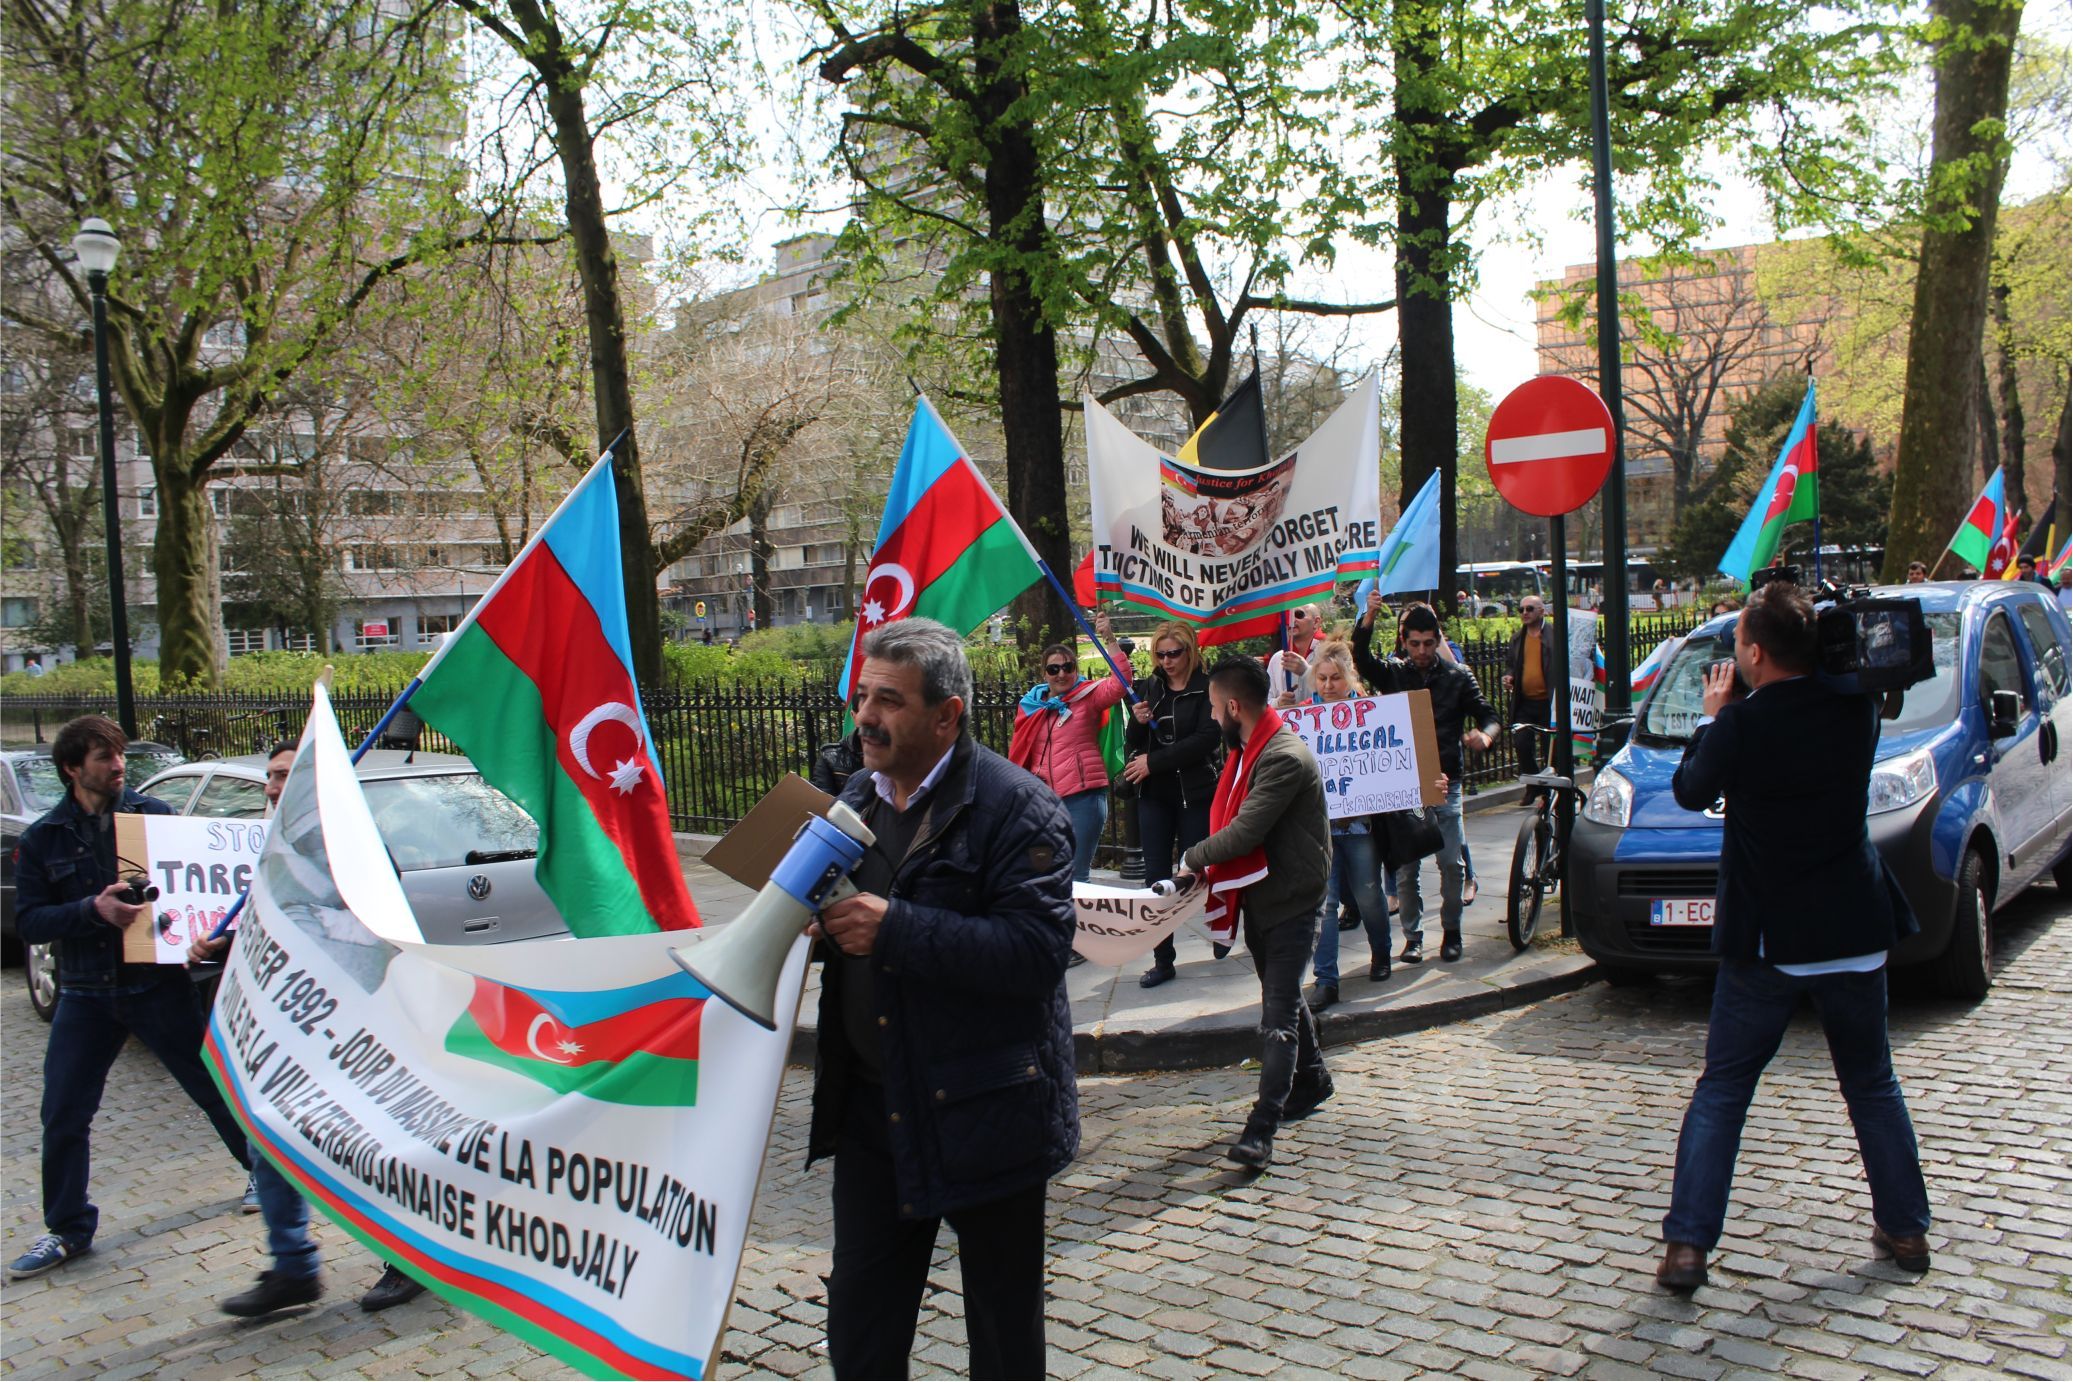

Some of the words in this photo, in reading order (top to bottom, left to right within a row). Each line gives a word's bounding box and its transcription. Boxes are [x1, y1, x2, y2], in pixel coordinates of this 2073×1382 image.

[1194, 474, 1233, 489] Justice
[1235, 477, 1254, 490] for
[1131, 525, 1151, 559] WE
[1153, 543, 1194, 581] WILL
[1200, 548, 1261, 585] NEVER
[1264, 506, 1338, 552] FORGET
[1180, 584, 1205, 607] OF
[1282, 700, 1376, 734] STOP
[1665, 902, 1715, 922] 1-EC
[245, 1028, 280, 1081] LA
[260, 1056, 328, 1121] VILLE
[271, 969, 338, 1036] 1992
[329, 1028, 395, 1089] JOUR
[366, 1066, 420, 1104] DU
[456, 1120, 497, 1173] DE
[500, 1131, 536, 1190] LA
[547, 1146, 717, 1257] POPULATION
[293, 1100, 476, 1240] AZERBAIDJANAISE
[486, 1199, 639, 1300] KHODJALY
